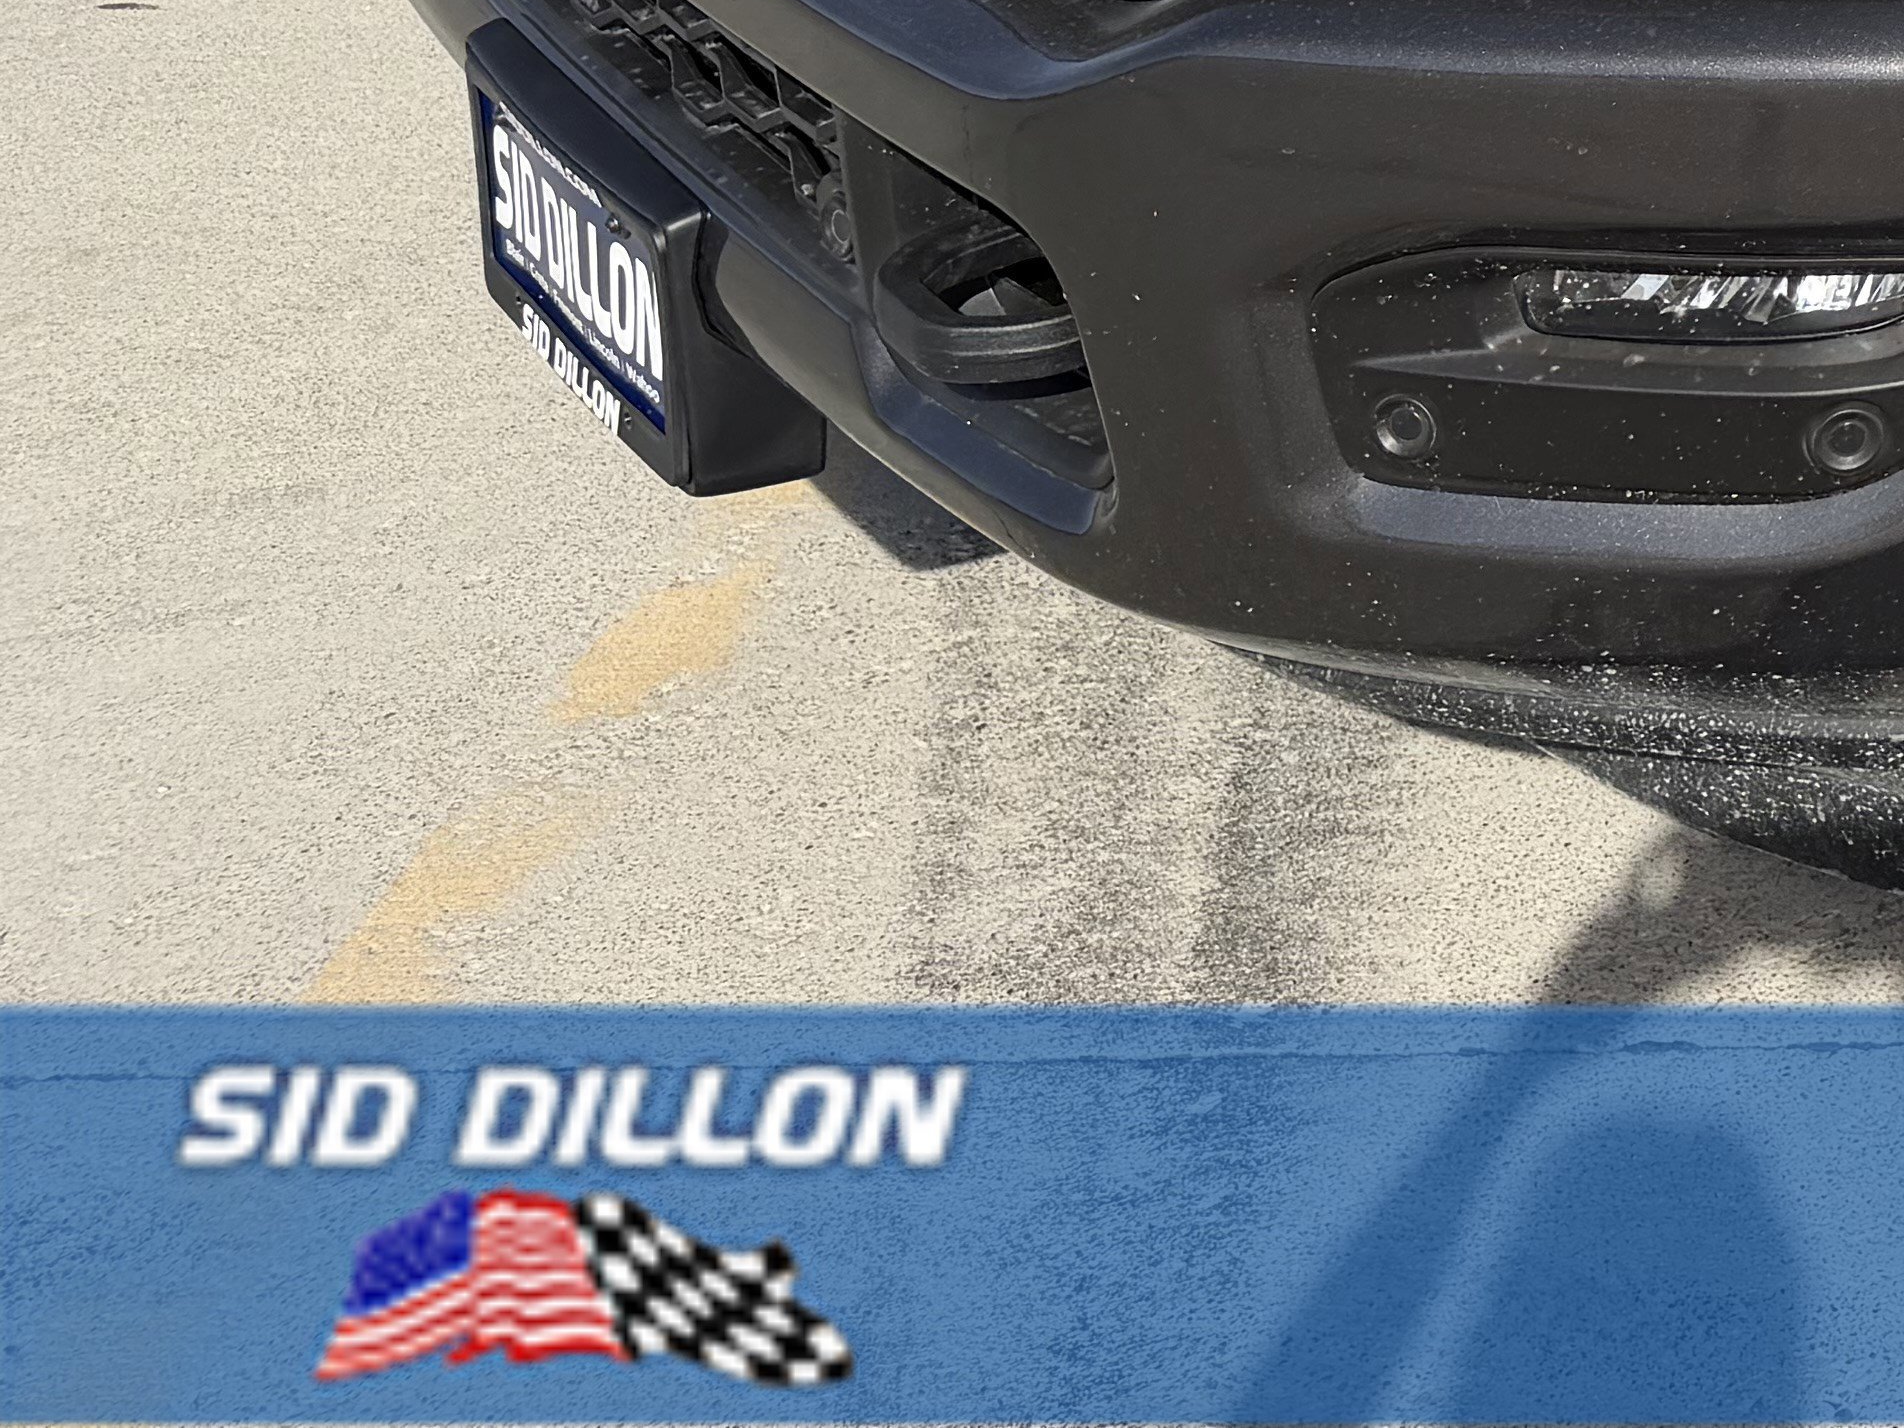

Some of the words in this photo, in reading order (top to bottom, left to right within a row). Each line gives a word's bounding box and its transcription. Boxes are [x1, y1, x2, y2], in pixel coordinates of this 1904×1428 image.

[493, 124, 542, 262] SID
[541, 176, 664, 382] DILLON
[521, 302, 551, 363] SID
[553, 334, 621, 437] DILLON
